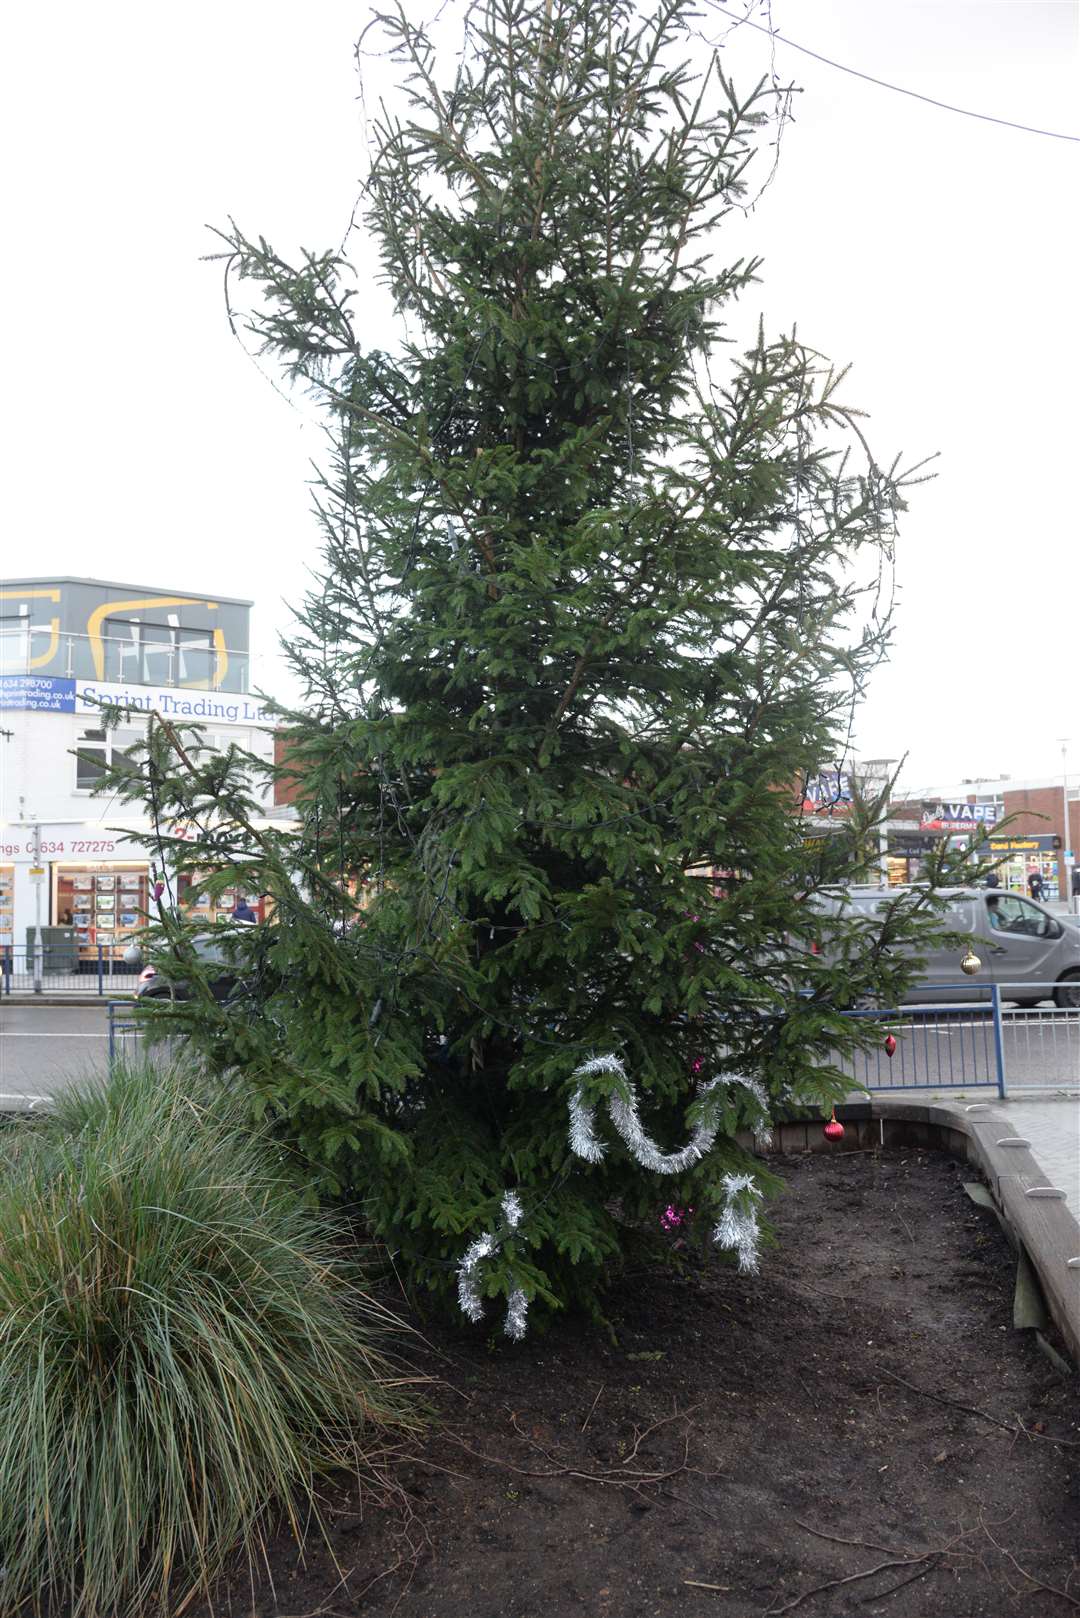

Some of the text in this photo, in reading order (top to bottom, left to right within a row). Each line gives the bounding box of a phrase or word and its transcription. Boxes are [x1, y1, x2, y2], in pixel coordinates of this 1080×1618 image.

[82, 687, 152, 712] Sprint
[159, 694, 239, 722] Trading
[949, 804, 996, 820] VAPE
[25, 841, 65, 854] 0634
[70, 840, 115, 853] 727275
